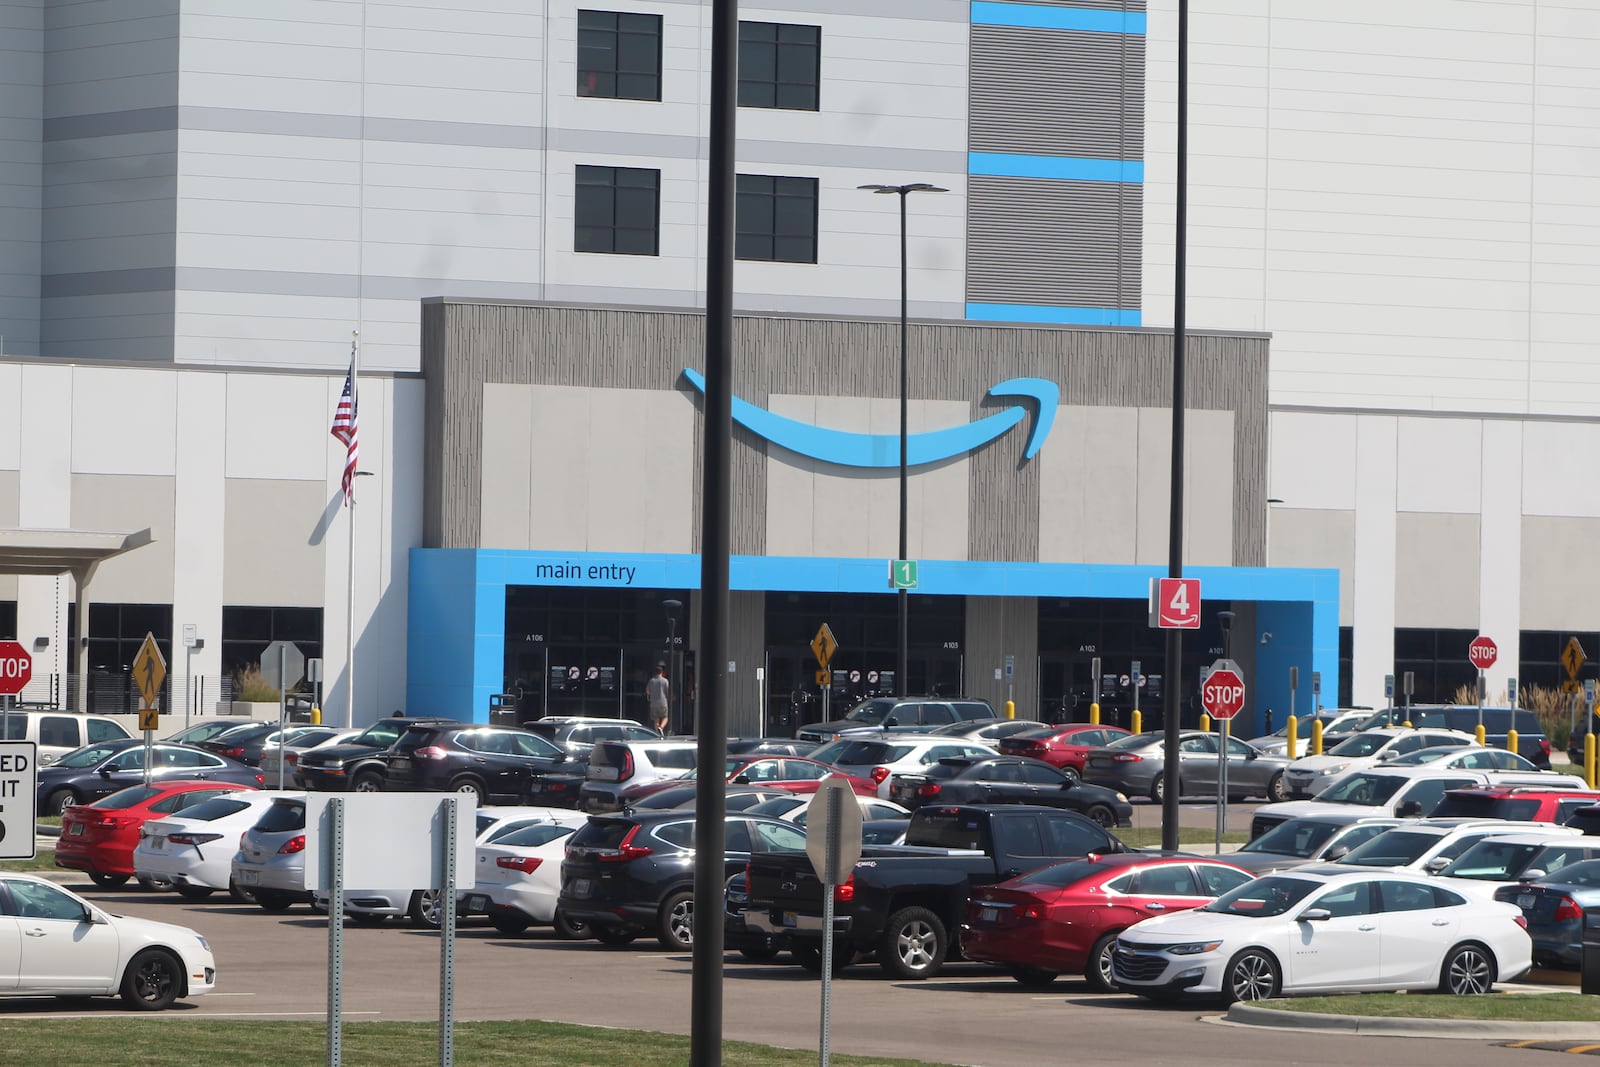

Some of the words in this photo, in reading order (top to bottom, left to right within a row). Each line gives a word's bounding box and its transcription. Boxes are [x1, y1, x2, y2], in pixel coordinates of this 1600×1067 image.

[536, 561, 581, 579] main
[588, 563, 636, 585] entry
[902, 562, 910, 582] 1
[1170, 583, 1190, 616] 4
[526, 634, 544, 642] A106
[665, 636, 683, 644] A05
[943, 641, 959, 649] A103
[1471, 646, 1496, 660] STOP
[0, 658, 29, 678] TOP
[1205, 685, 1243, 704] STOP
